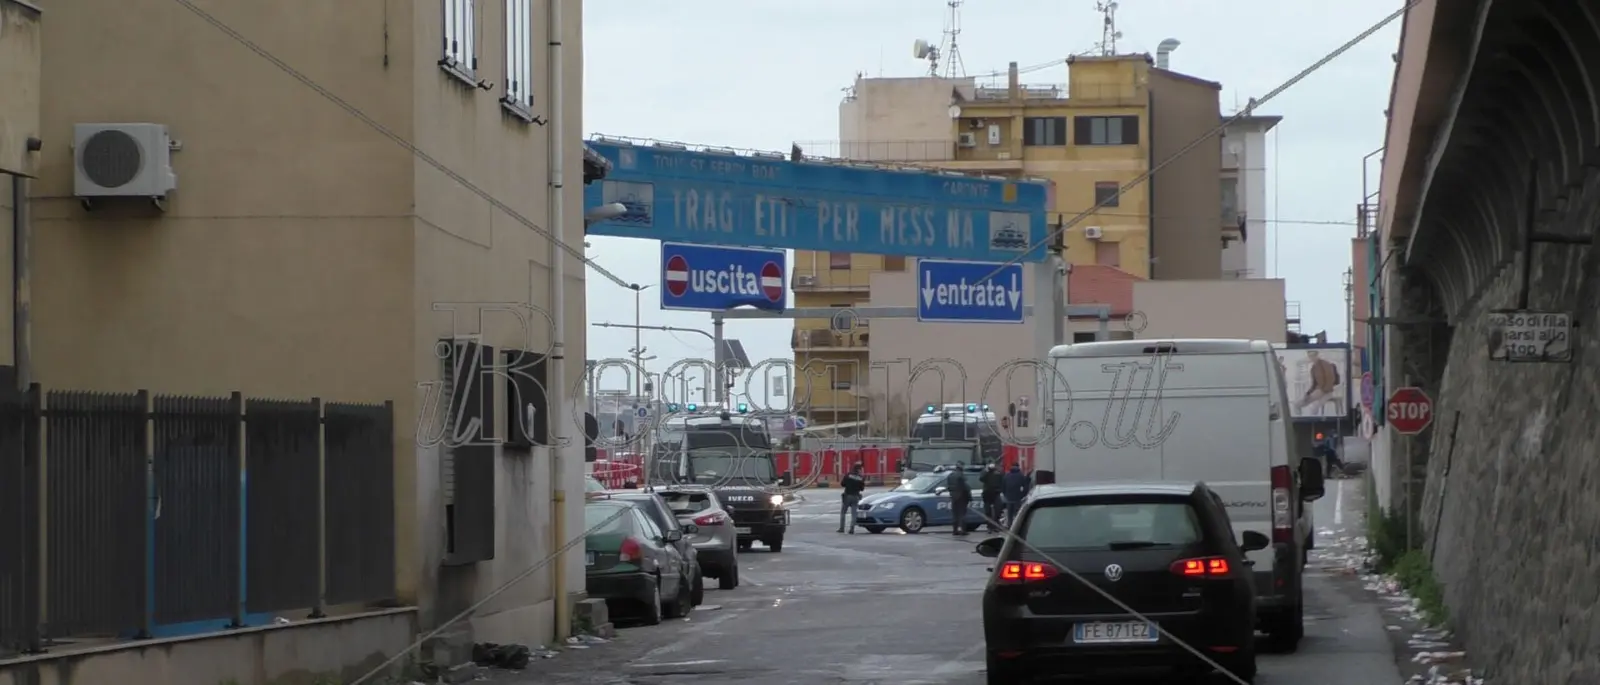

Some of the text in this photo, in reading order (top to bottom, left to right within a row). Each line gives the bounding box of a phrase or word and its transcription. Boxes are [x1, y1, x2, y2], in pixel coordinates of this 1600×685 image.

[672, 188, 975, 248] TRAGETT PER MESSNA
[692, 263, 760, 295] uscita
[937, 277, 1006, 306] entrata
[1527, 314, 1541, 328] di
[1388, 402, 1429, 419] STOP
[1084, 623, 1148, 638] FE 871EZ
